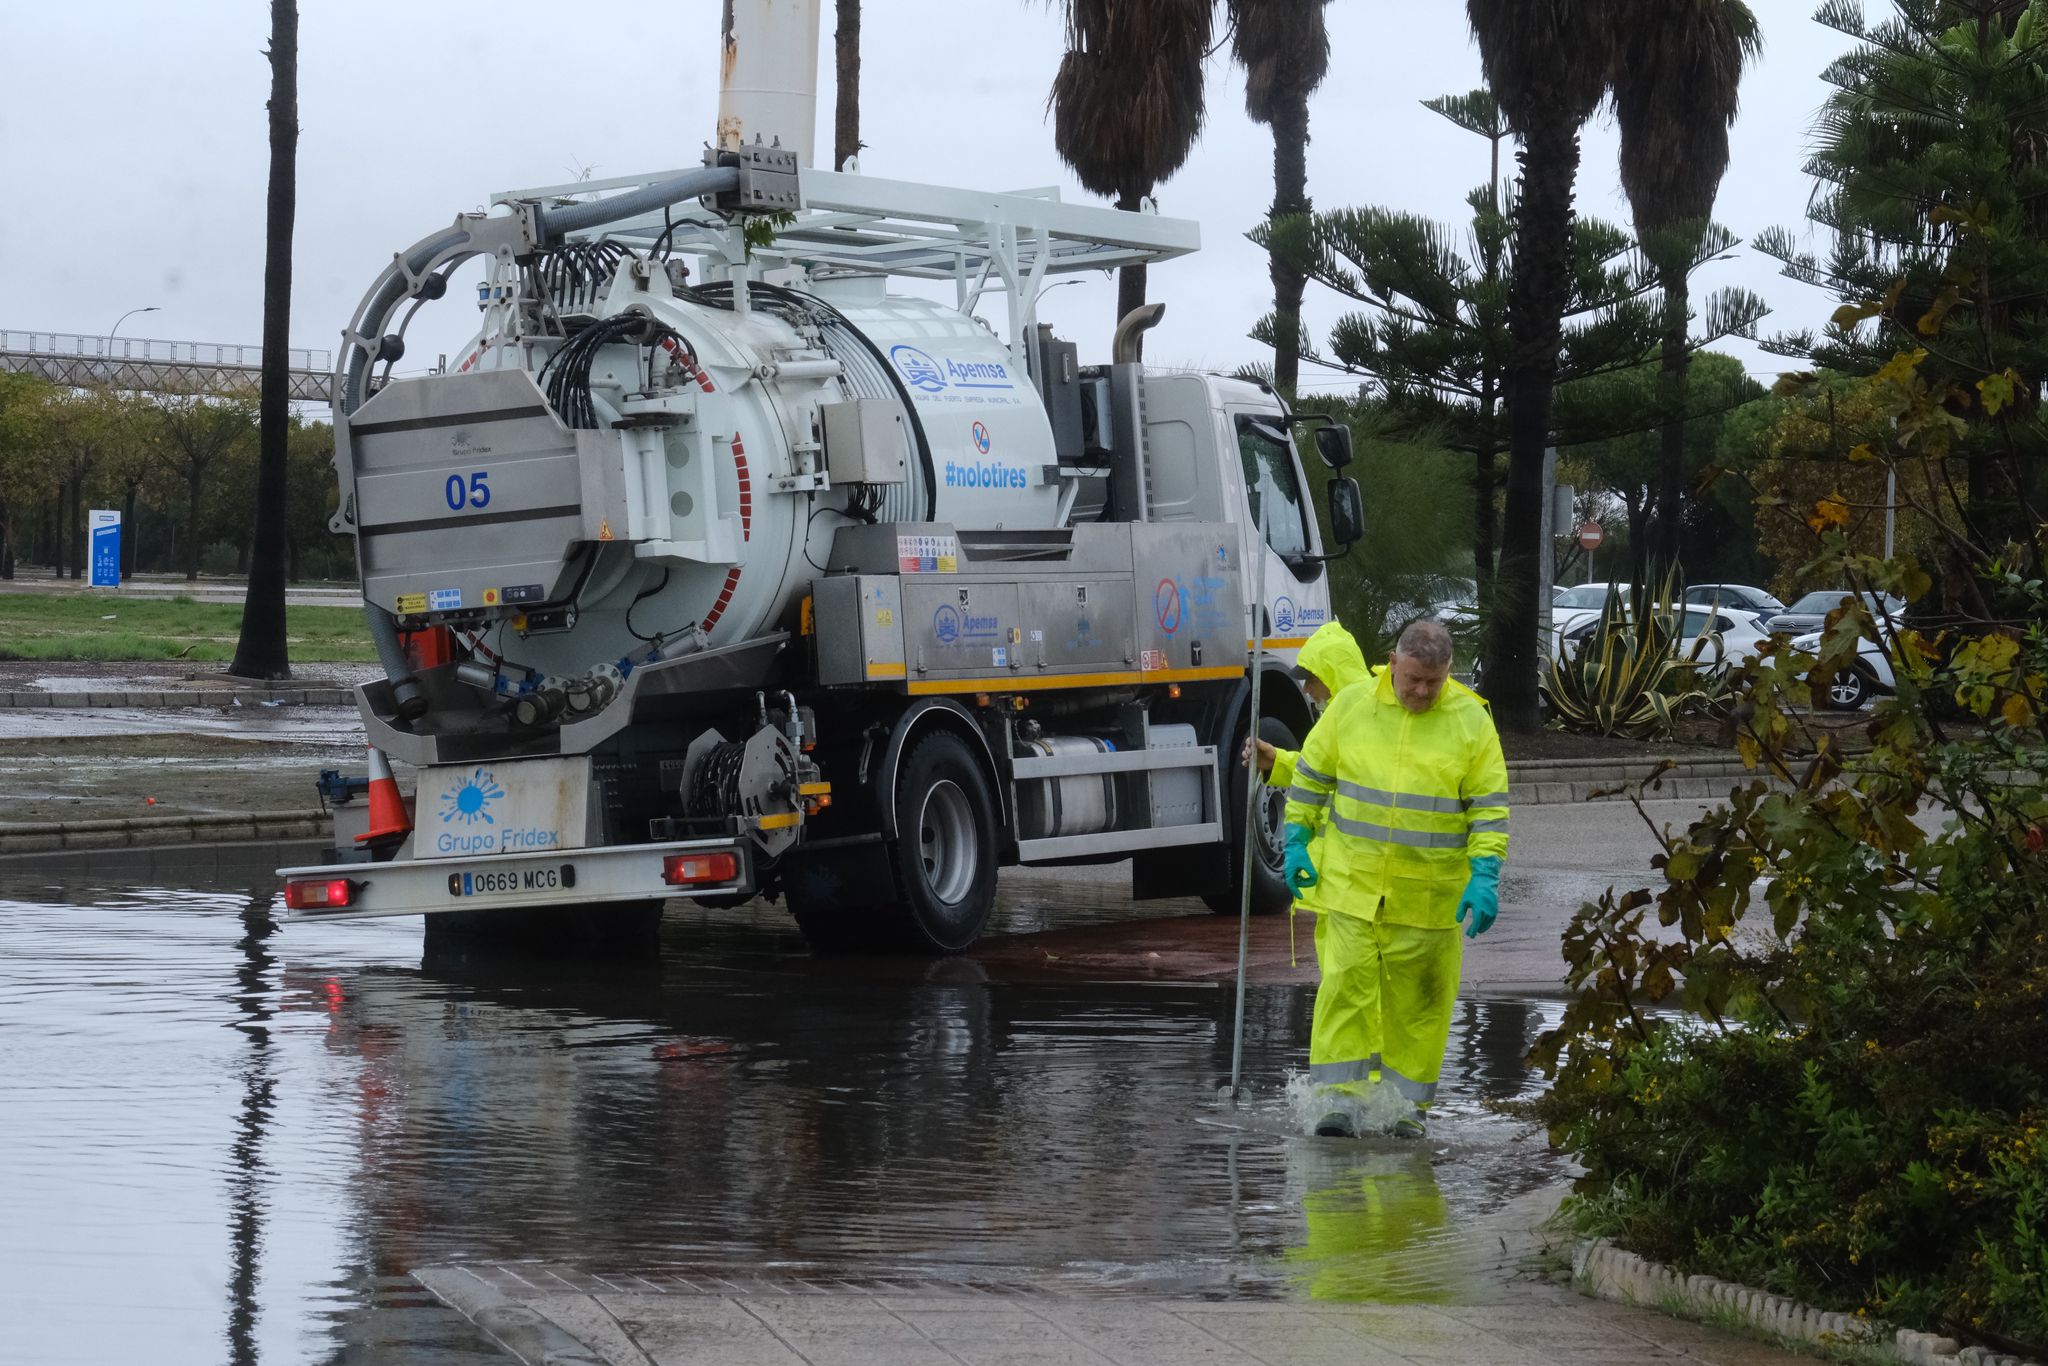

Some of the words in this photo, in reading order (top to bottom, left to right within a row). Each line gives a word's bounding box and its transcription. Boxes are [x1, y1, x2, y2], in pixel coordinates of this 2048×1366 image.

[945, 358, 1008, 382] Apemsa
[945, 460, 1026, 488] #nolotires
[446, 472, 490, 510] 05
[963, 615, 998, 632] Apemsa
[1298, 605, 1325, 623] Apemsa
[438, 833, 495, 854] Grupo
[501, 828, 559, 850] Fridex
[475, 872, 518, 892] 0669
[524, 870, 557, 889] MCG
